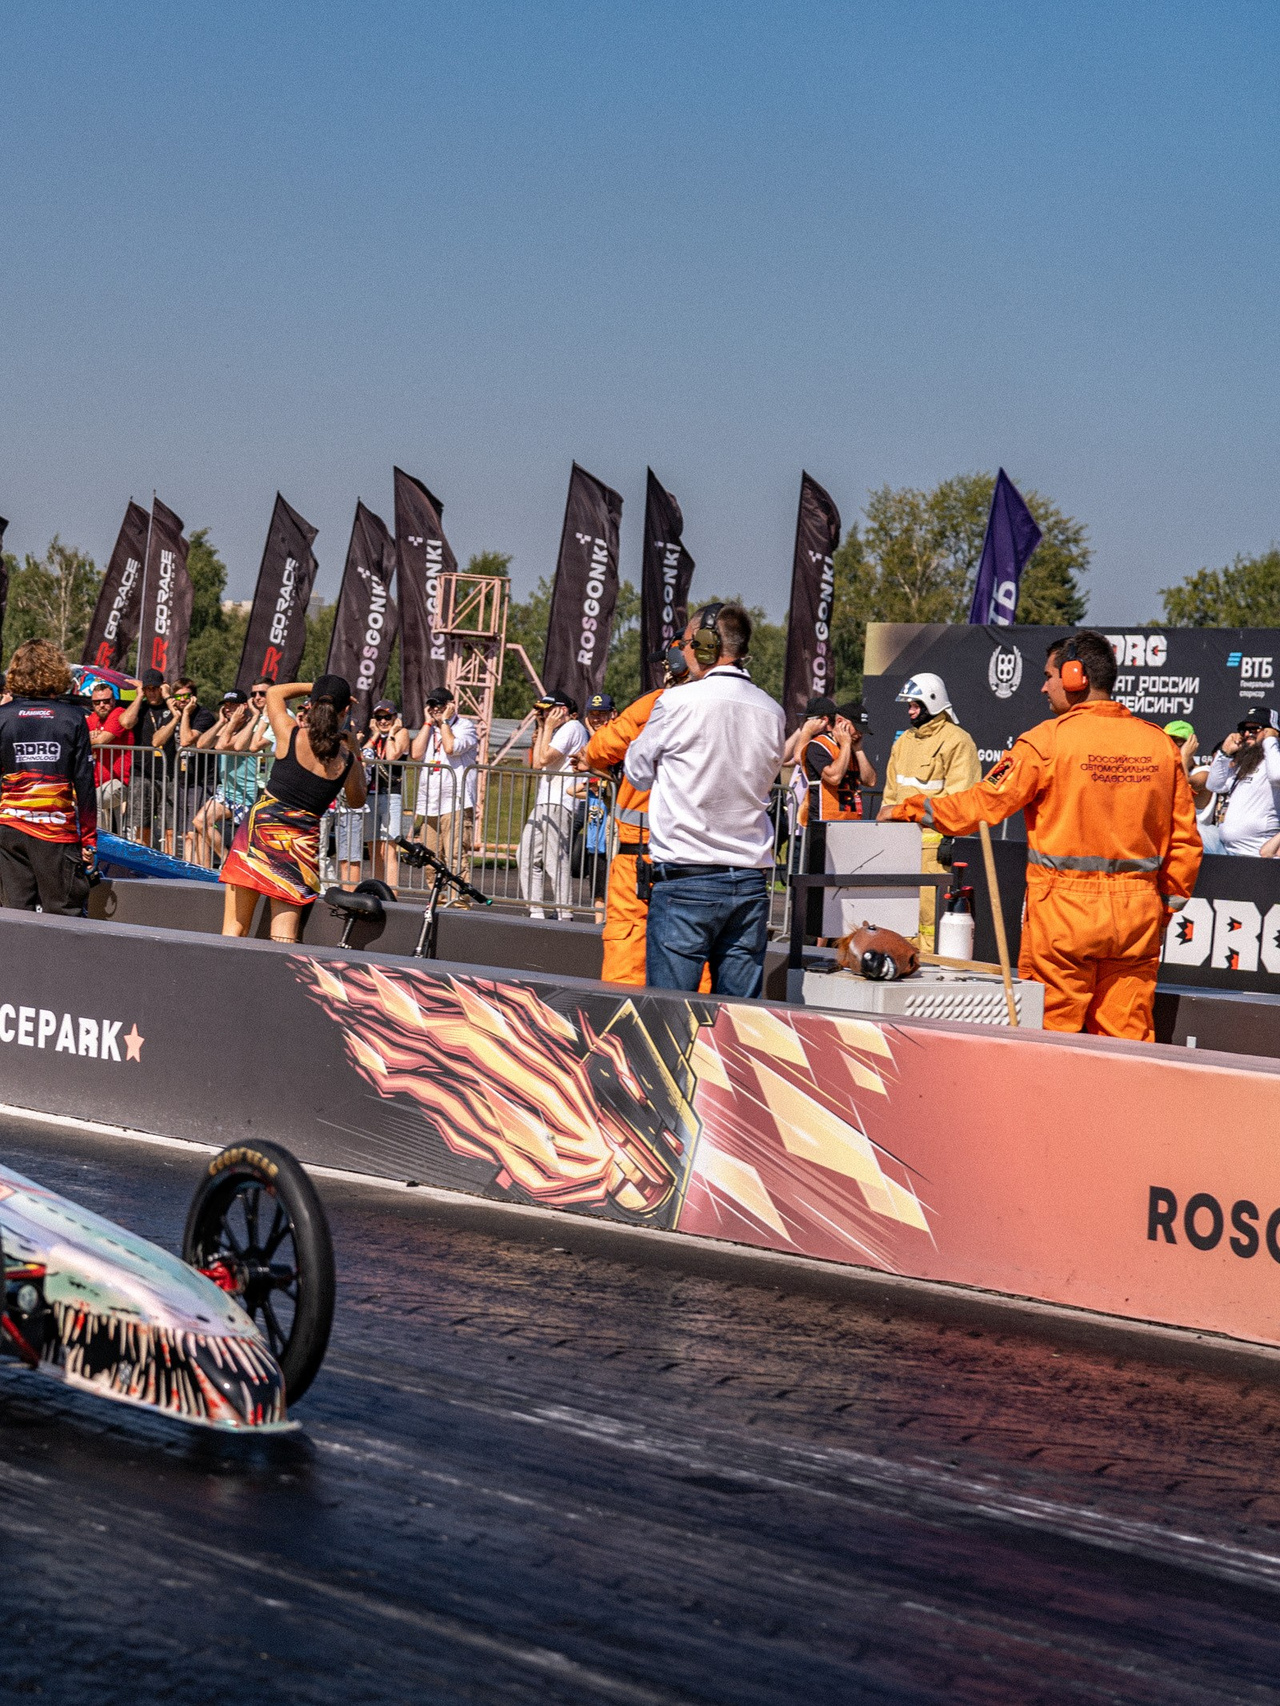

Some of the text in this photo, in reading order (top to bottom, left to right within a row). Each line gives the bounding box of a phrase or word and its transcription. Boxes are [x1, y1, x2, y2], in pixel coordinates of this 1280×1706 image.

[577, 538, 608, 666] ROSGONKI
[357, 575, 386, 691] ROSGONKI
[812, 556, 834, 694] ROSGONKI
[1105, 634, 1167, 667] DRC
[1241, 657, 1273, 678] ВТБ
[1139, 675, 1200, 694] РОССИИ
[15, 743, 59, 755] RDRC
[1087, 754, 1152, 764] российская
[1080, 763, 1159, 774] автомобильная
[1091, 772, 1151, 783] федерация
